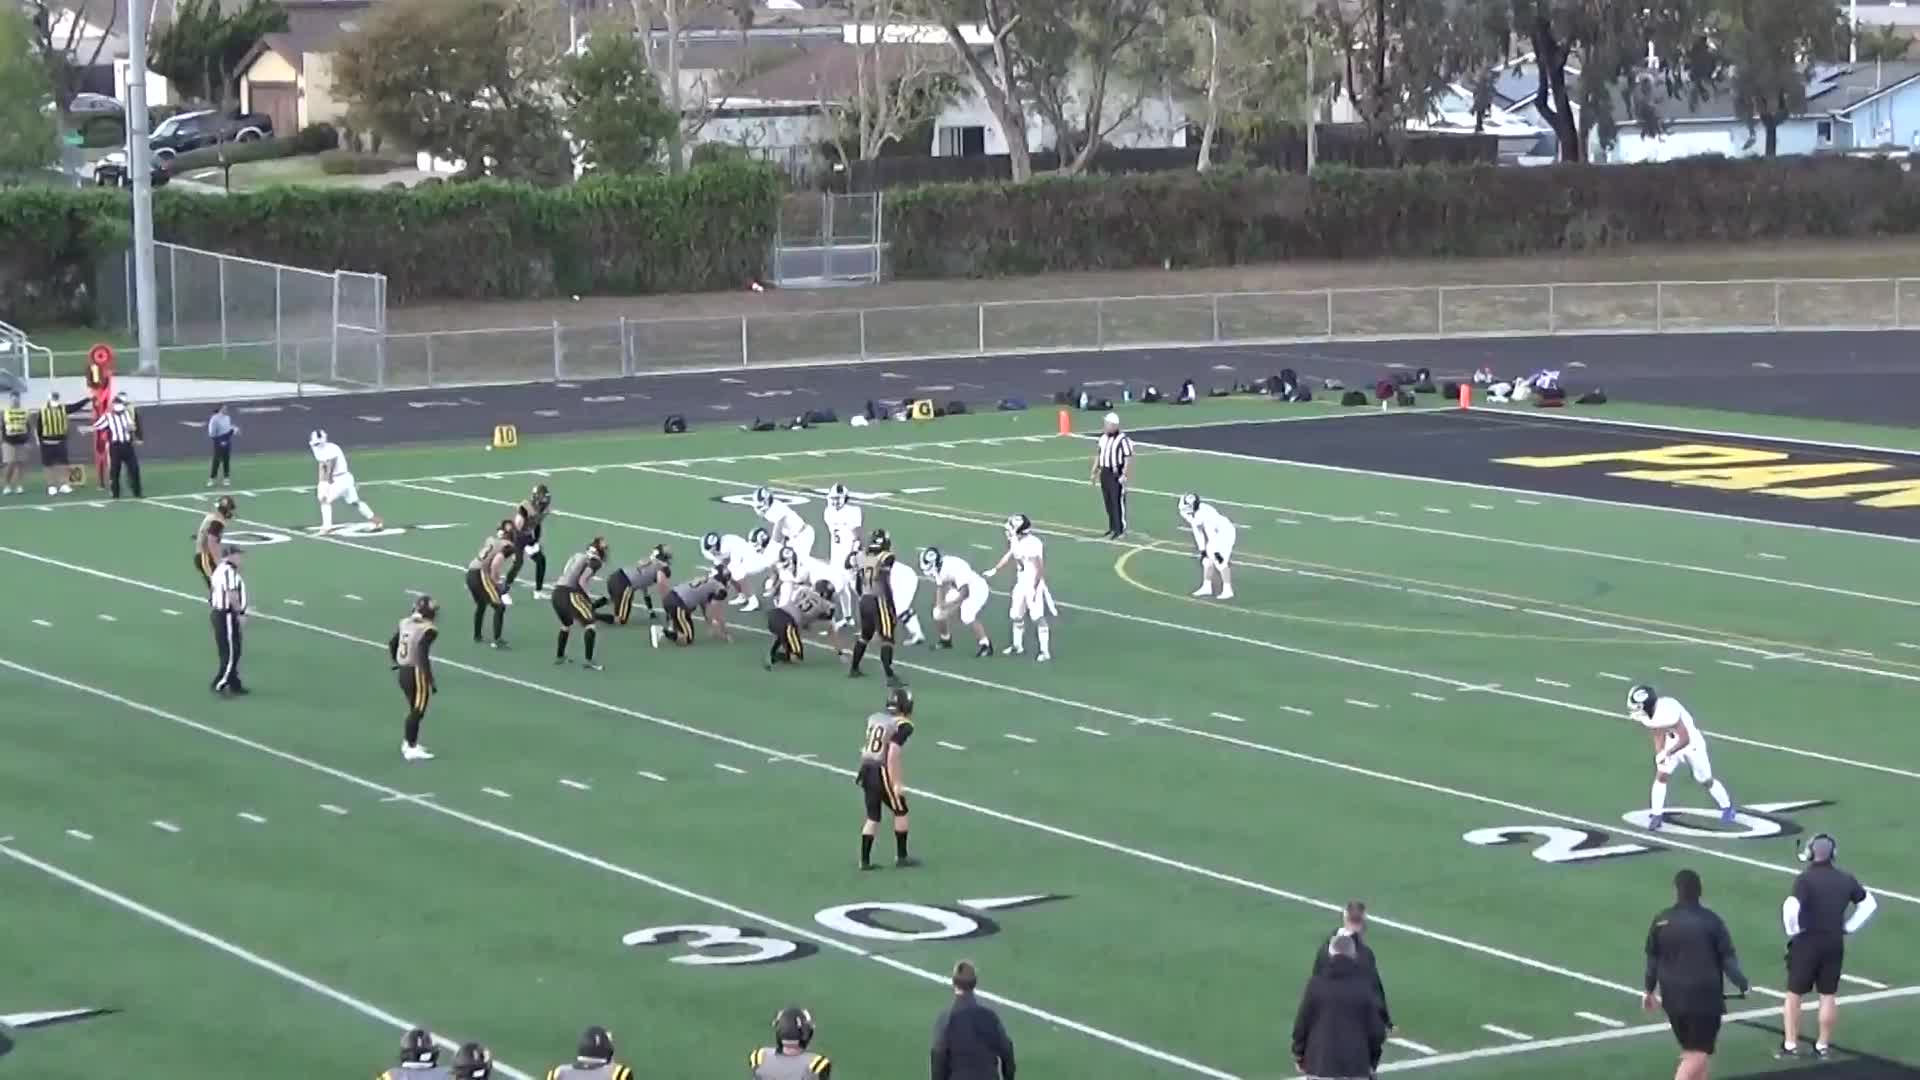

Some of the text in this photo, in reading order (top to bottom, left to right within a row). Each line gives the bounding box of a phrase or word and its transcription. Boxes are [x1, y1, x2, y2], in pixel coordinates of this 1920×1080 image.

[499, 427, 515, 444] 10
[1462, 807, 1782, 863] 20
[622, 901, 980, 965] 30
